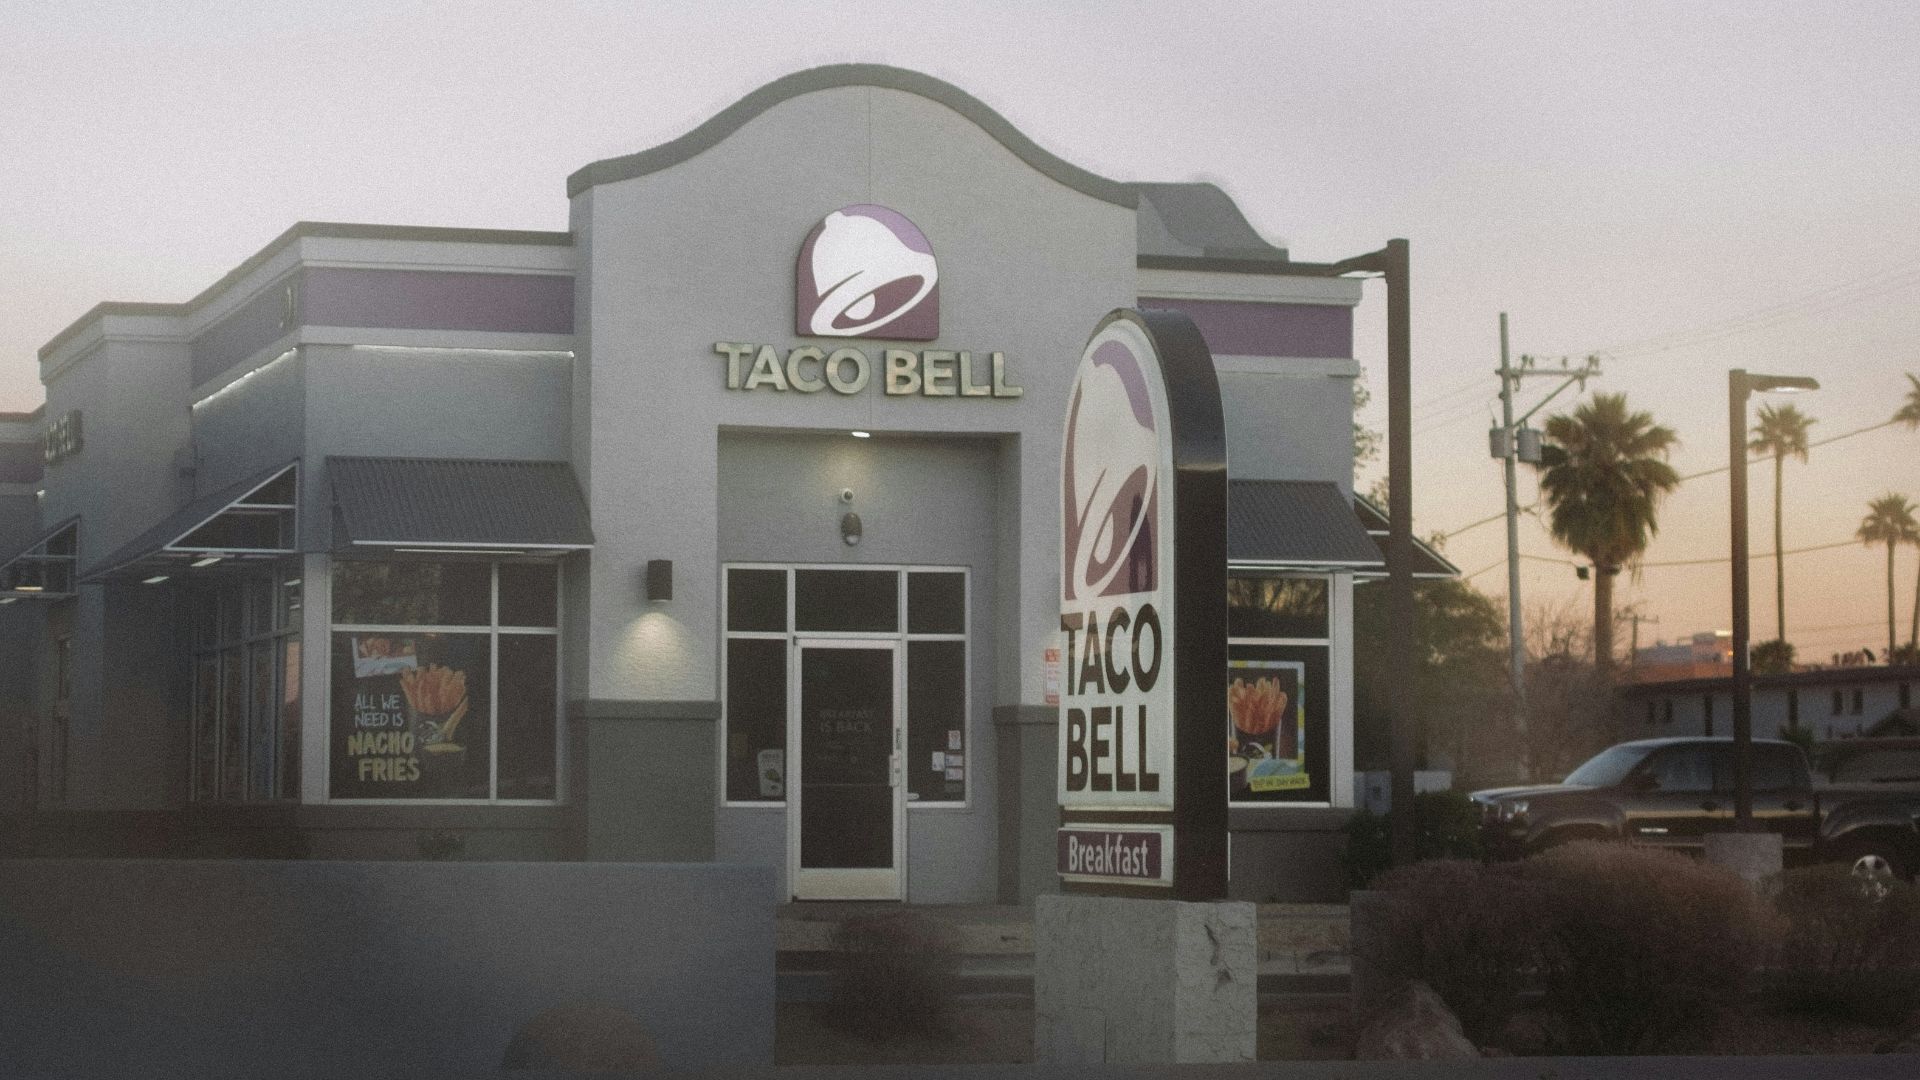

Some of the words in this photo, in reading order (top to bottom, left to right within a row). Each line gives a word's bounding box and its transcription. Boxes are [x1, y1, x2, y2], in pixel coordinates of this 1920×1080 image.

[714, 342, 871, 395] TACO
[884, 349, 1024, 398] BELL
[1060, 603, 1162, 696] TACO
[353, 694, 376, 711] ALL
[382, 695, 400, 710] WE
[354, 712, 389, 728] NEED
[391, 713, 404, 728] IS
[347, 731, 415, 756] NACHO
[1066, 705, 1160, 792] BELL
[358, 757, 420, 782] FRIES
[1068, 834, 1149, 876] Breakfast
